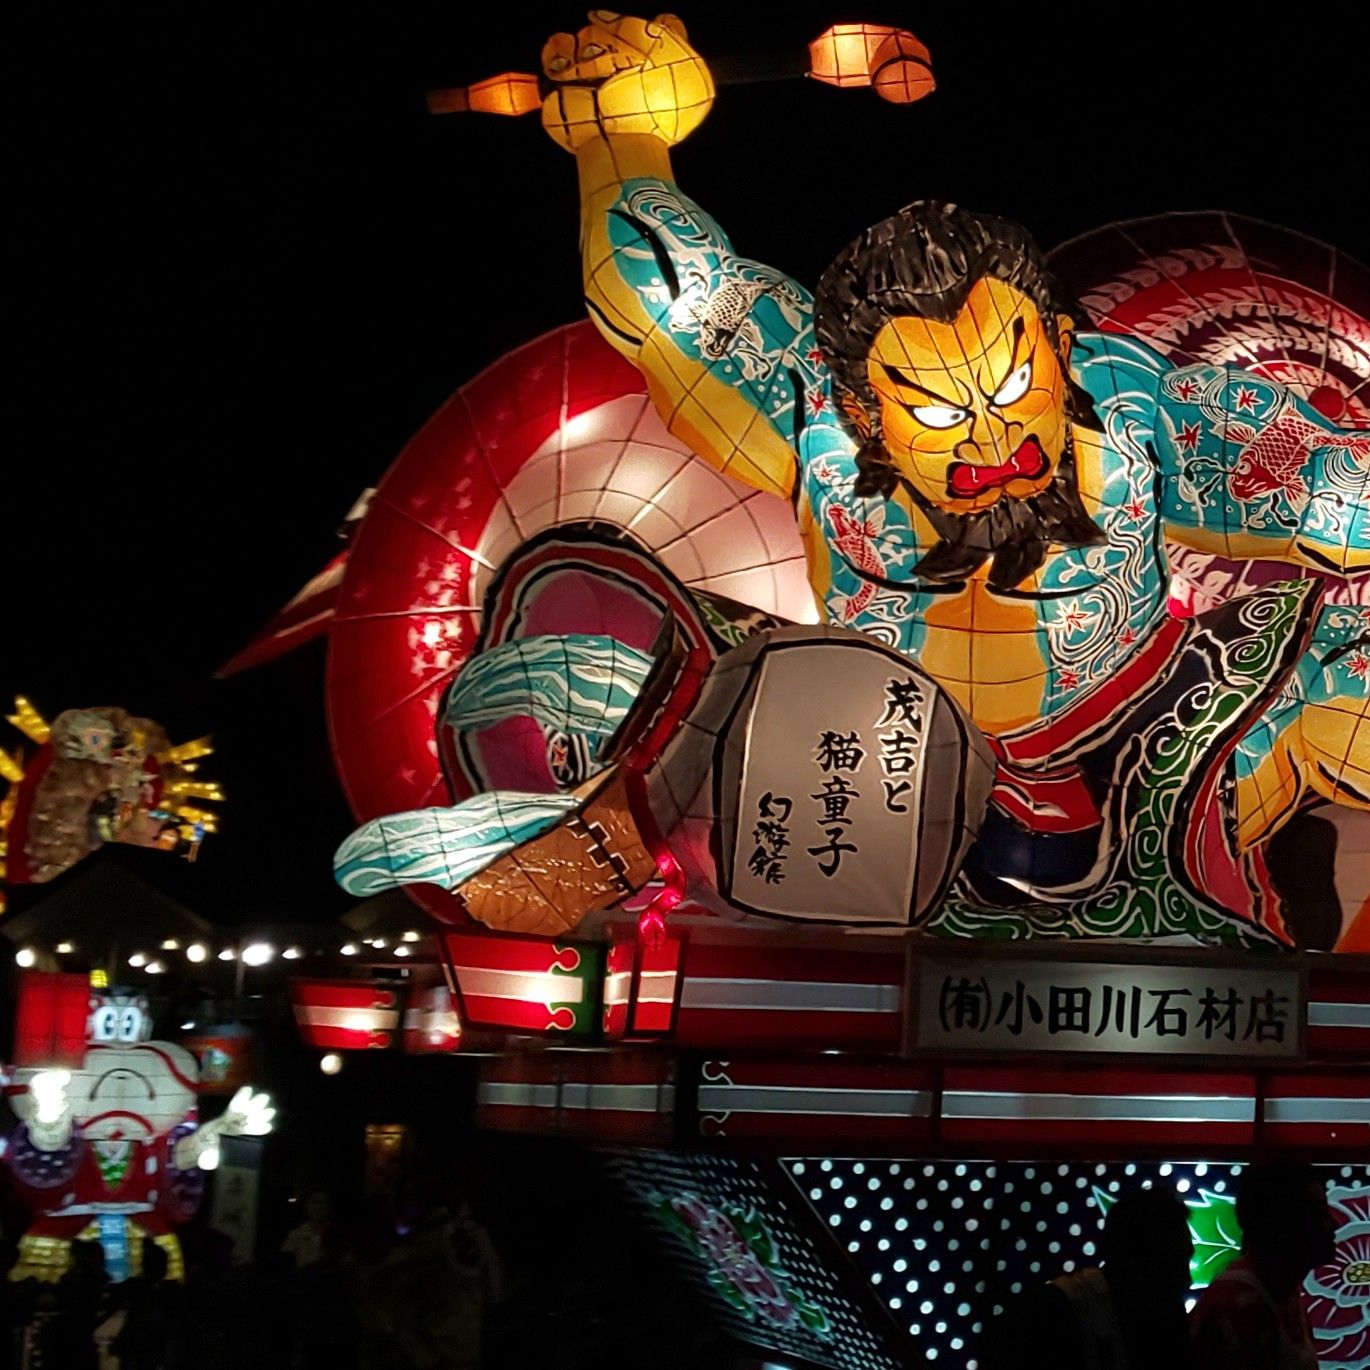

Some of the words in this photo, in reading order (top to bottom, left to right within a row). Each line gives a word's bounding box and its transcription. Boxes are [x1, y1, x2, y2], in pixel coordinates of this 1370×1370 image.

[807, 731, 866, 878] 猫童子
[876, 677, 923, 813] 茂吉と
